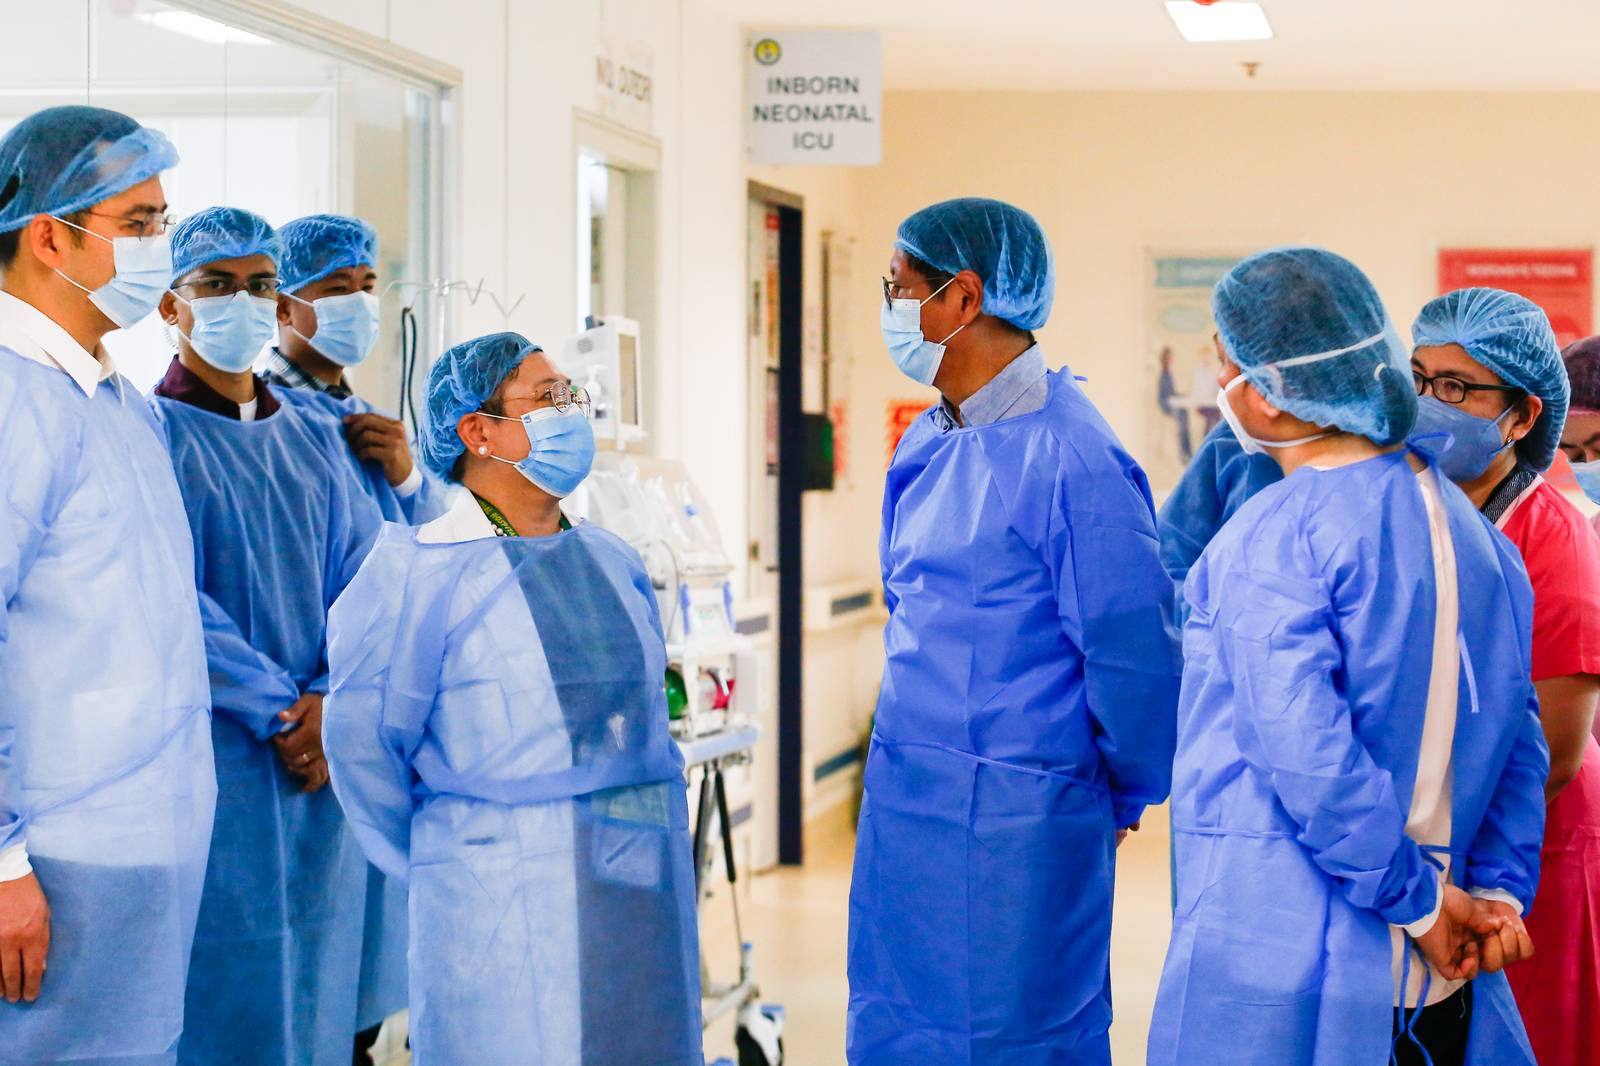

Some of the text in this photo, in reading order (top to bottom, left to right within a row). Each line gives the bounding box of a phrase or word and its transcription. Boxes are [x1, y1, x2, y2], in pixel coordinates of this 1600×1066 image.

[767, 76, 859, 95] INBORN
[753, 104, 874, 122] NEONATAL
[793, 131, 834, 150] ICU
[490, 511, 518, 537] HOSPITA
